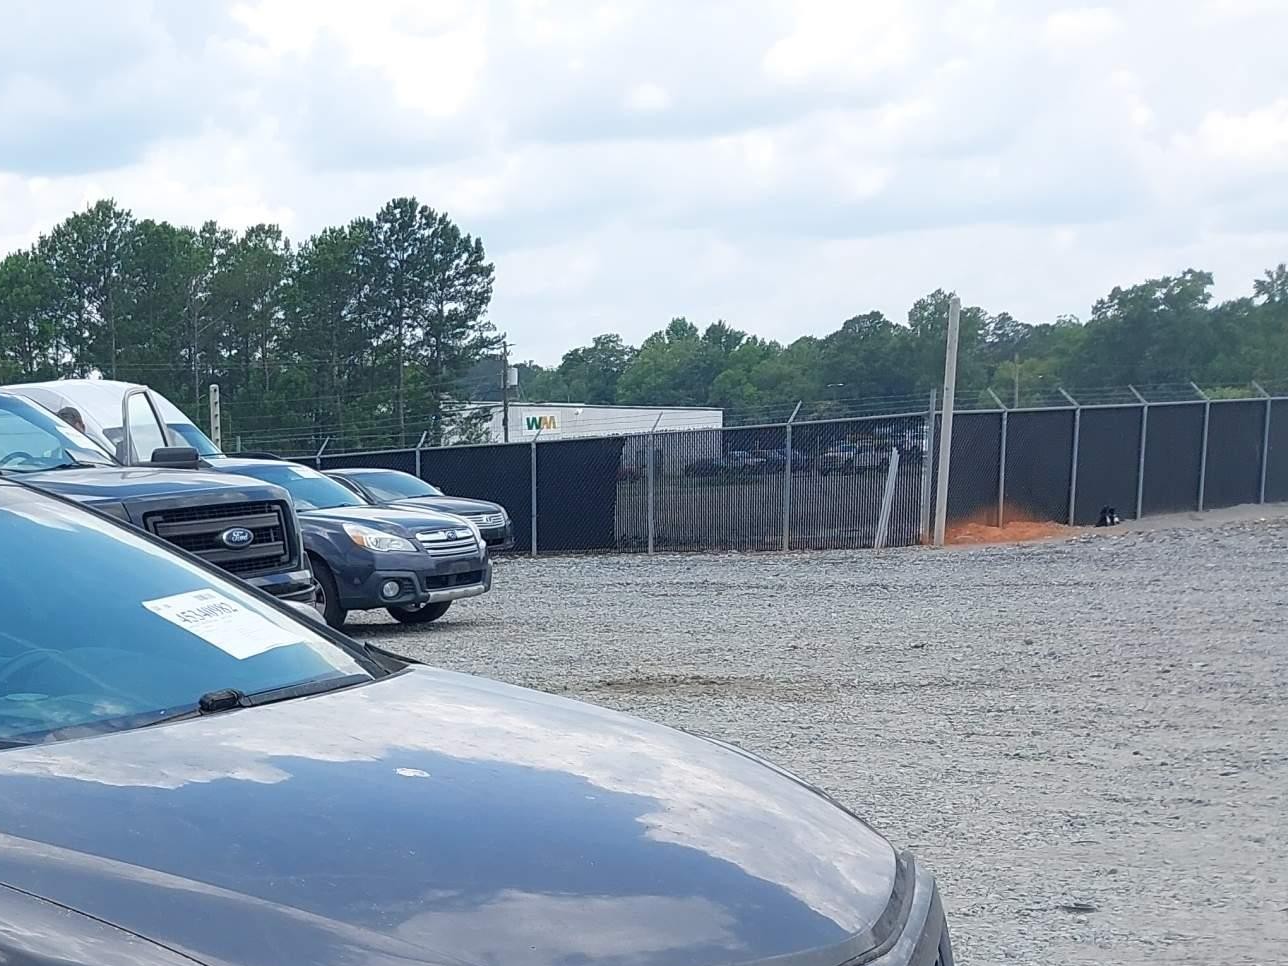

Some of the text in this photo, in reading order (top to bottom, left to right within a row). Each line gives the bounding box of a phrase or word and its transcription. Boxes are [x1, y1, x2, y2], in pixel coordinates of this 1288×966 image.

[526, 416, 557, 430] WM
[231, 530, 249, 542] Ford
[175, 602, 239, 624] 45340982
